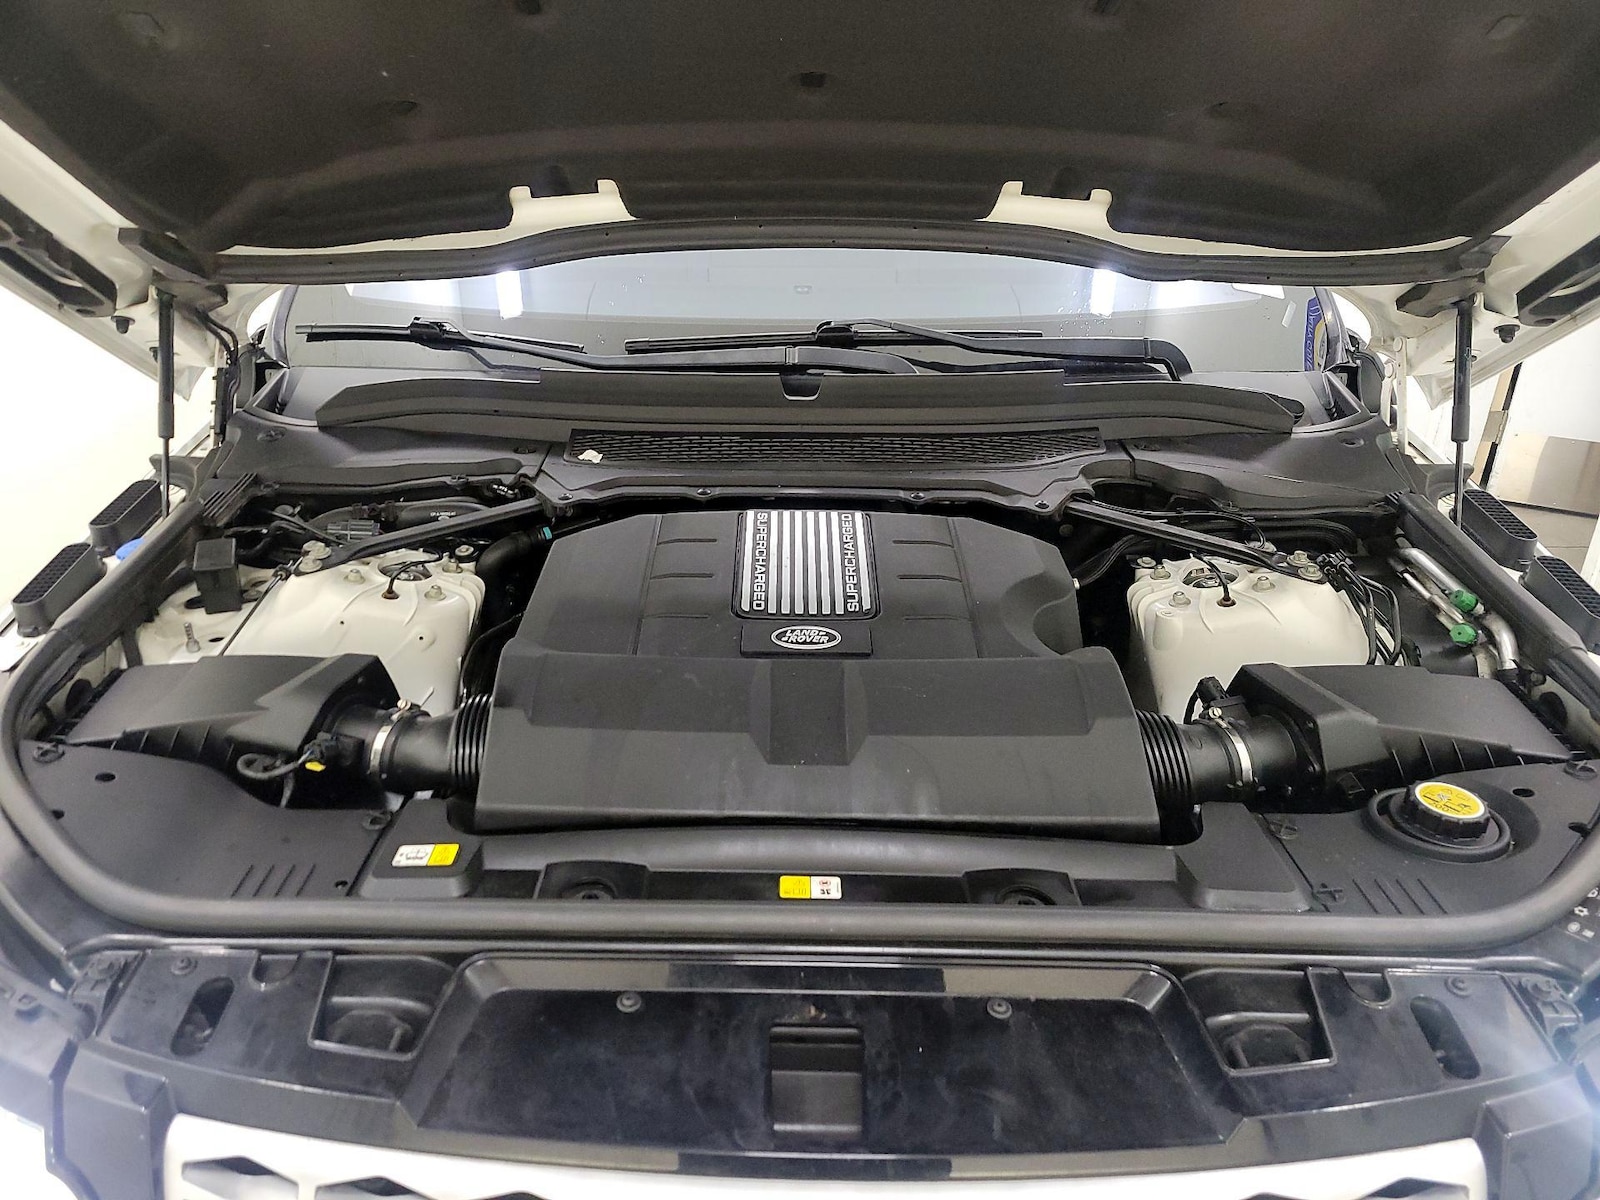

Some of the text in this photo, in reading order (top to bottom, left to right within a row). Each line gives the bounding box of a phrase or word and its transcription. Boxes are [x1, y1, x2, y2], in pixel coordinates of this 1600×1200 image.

[752, 512, 768, 611] SUPERCHARGED
[841, 513, 860, 612] SUPERCHARGED
[785, 629, 819, 637] LAND
[787, 635, 829, 643] ROVER
